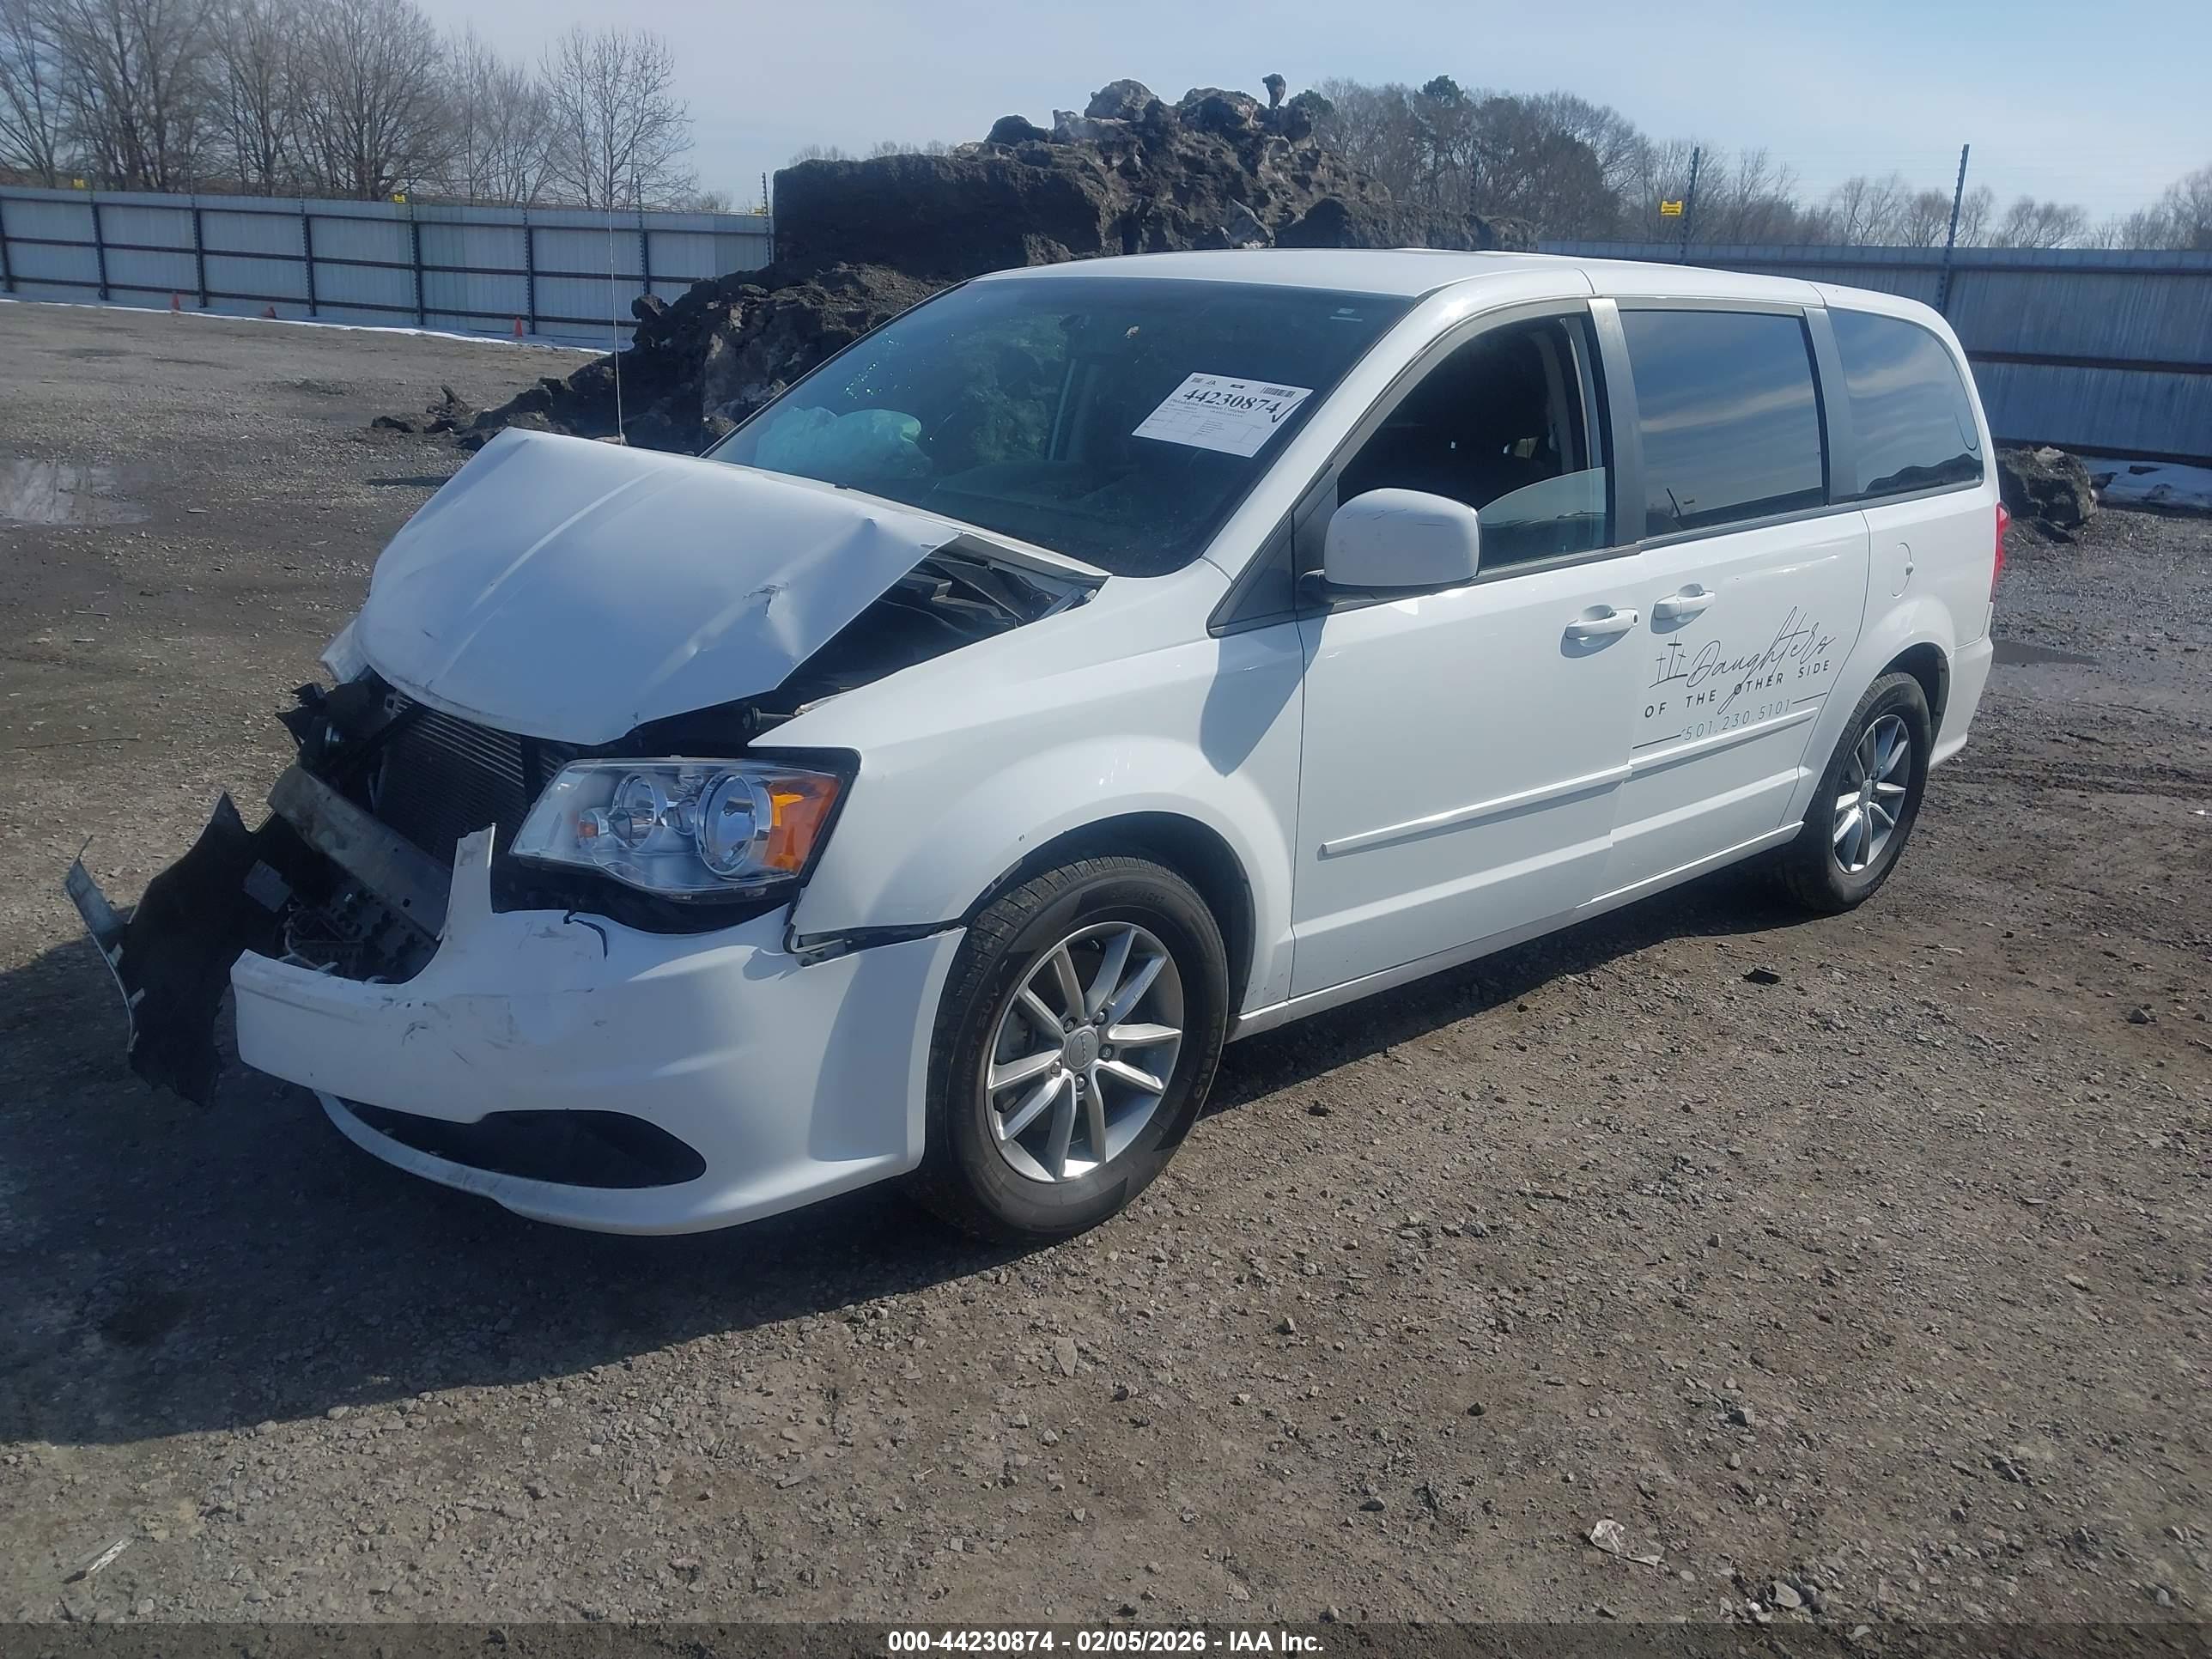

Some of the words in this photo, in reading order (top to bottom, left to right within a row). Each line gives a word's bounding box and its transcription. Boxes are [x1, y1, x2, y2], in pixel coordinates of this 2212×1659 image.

[1182, 389, 1282, 414] 44230874
[1686, 606, 1836, 714] Daughters
[1644, 702, 1668, 718] OF
[1686, 690, 1717, 708] THE
[1734, 672, 1784, 695] OTHER
[1798, 659, 1830, 678] SIDE
[1684, 699, 1790, 741] 501.230.5101
